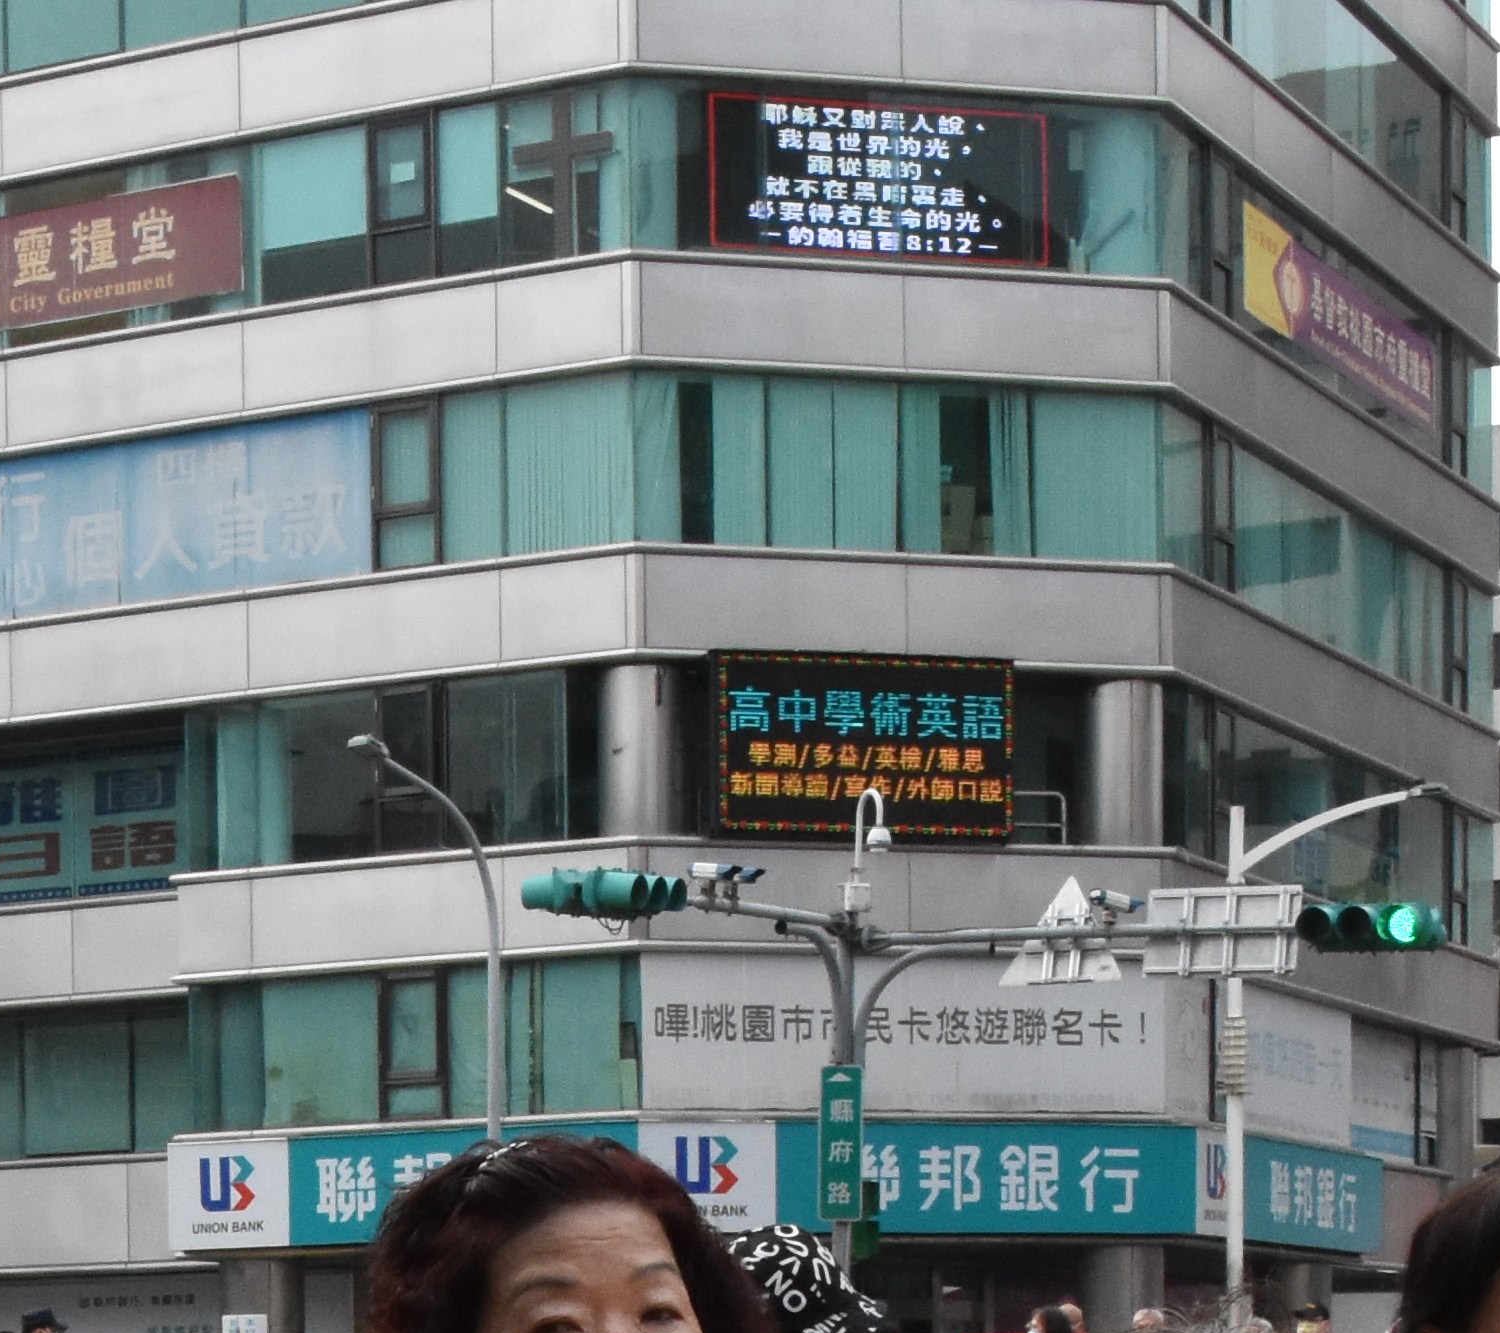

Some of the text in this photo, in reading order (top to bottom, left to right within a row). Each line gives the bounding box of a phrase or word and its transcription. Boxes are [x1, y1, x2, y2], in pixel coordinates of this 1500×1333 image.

[10, 291, 49, 318] City
[57, 270, 175, 307] Government
[728, 686, 1004, 740] 高中學術英語
[828, 1096, 854, 1206] 縣府路
[712, 1205, 748, 1217] BANK
[1270, 1161, 1356, 1232] 聯邦銀行
[192, 1220, 264, 1235] UNION BANK
